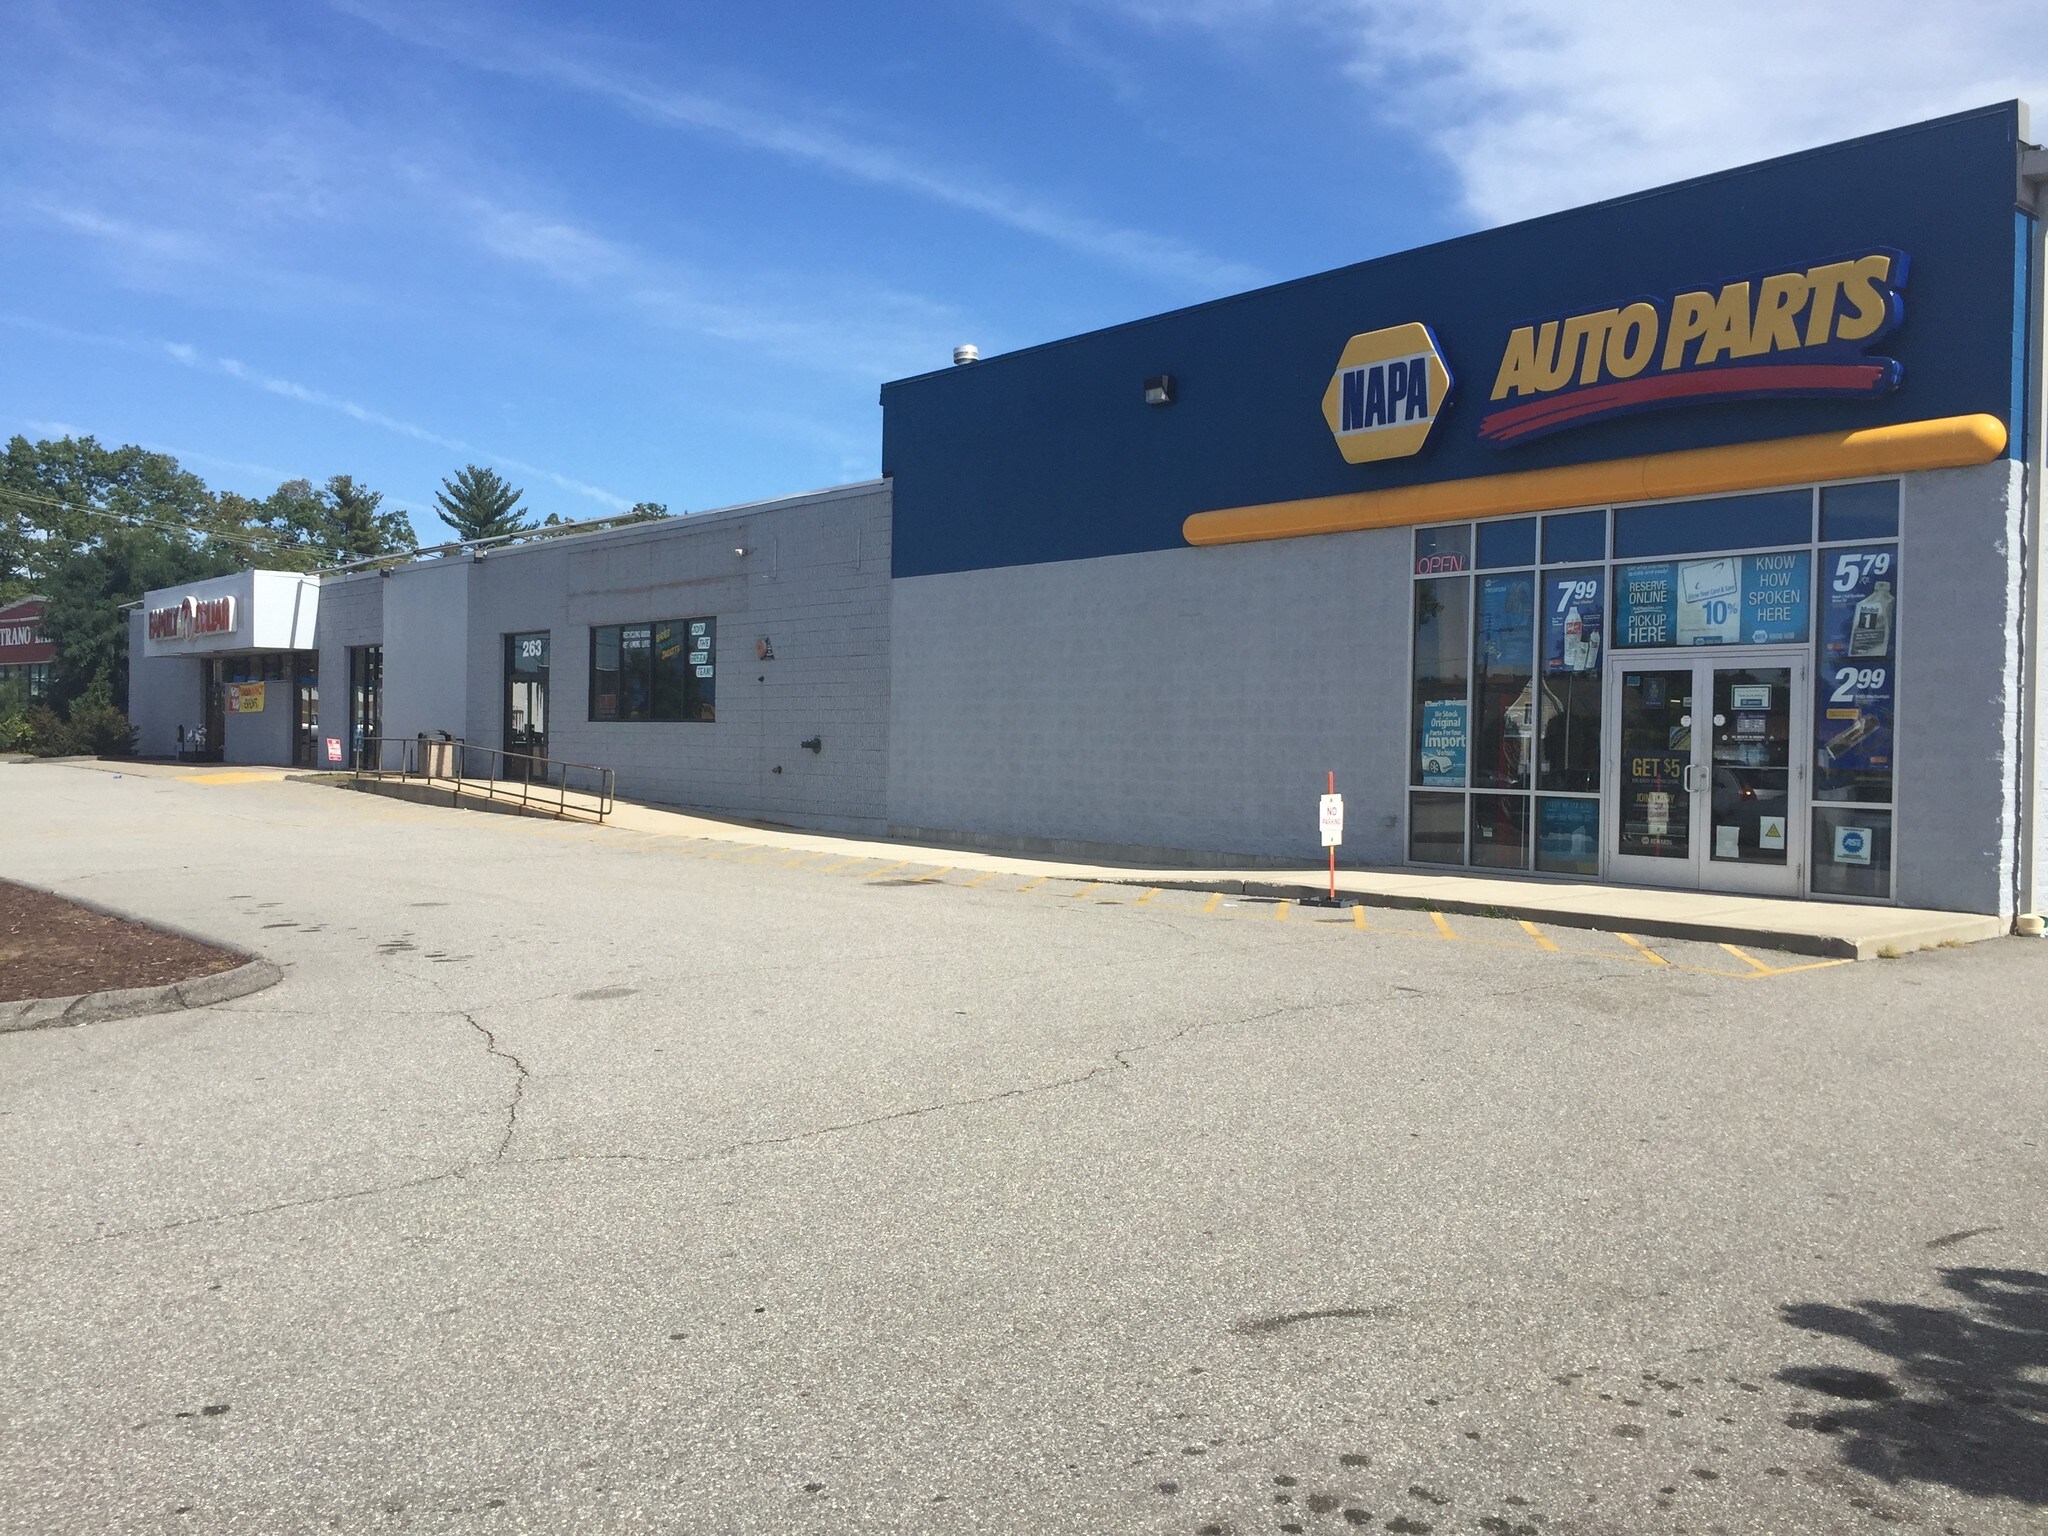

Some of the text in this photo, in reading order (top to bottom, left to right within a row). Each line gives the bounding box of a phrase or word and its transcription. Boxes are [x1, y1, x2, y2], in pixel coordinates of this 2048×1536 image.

[1490, 254, 1892, 400] AUTO PARTS
[1342, 357, 1428, 431] NAPA
[1418, 555, 1464, 575] OPEN
[1756, 555, 1796, 571] KNOW
[1629, 580, 1667, 592] RESERVE
[1760, 573, 1791, 587] HOW
[1629, 591, 1667, 604] ONLINE
[1749, 589, 1800, 605] SPOKEN
[1628, 614, 1667, 627] PICK UP
[1757, 607, 1791, 621] HERE
[1864, 613, 1871, 628] 1
[1628, 626, 1667, 643] HERE
[522, 639, 542, 657] 263
[1430, 717, 1461, 729] Original
[1425, 733, 1466, 749] Import
[1632, 757, 1681, 778] GET $5
[1327, 806, 1338, 816] NO
